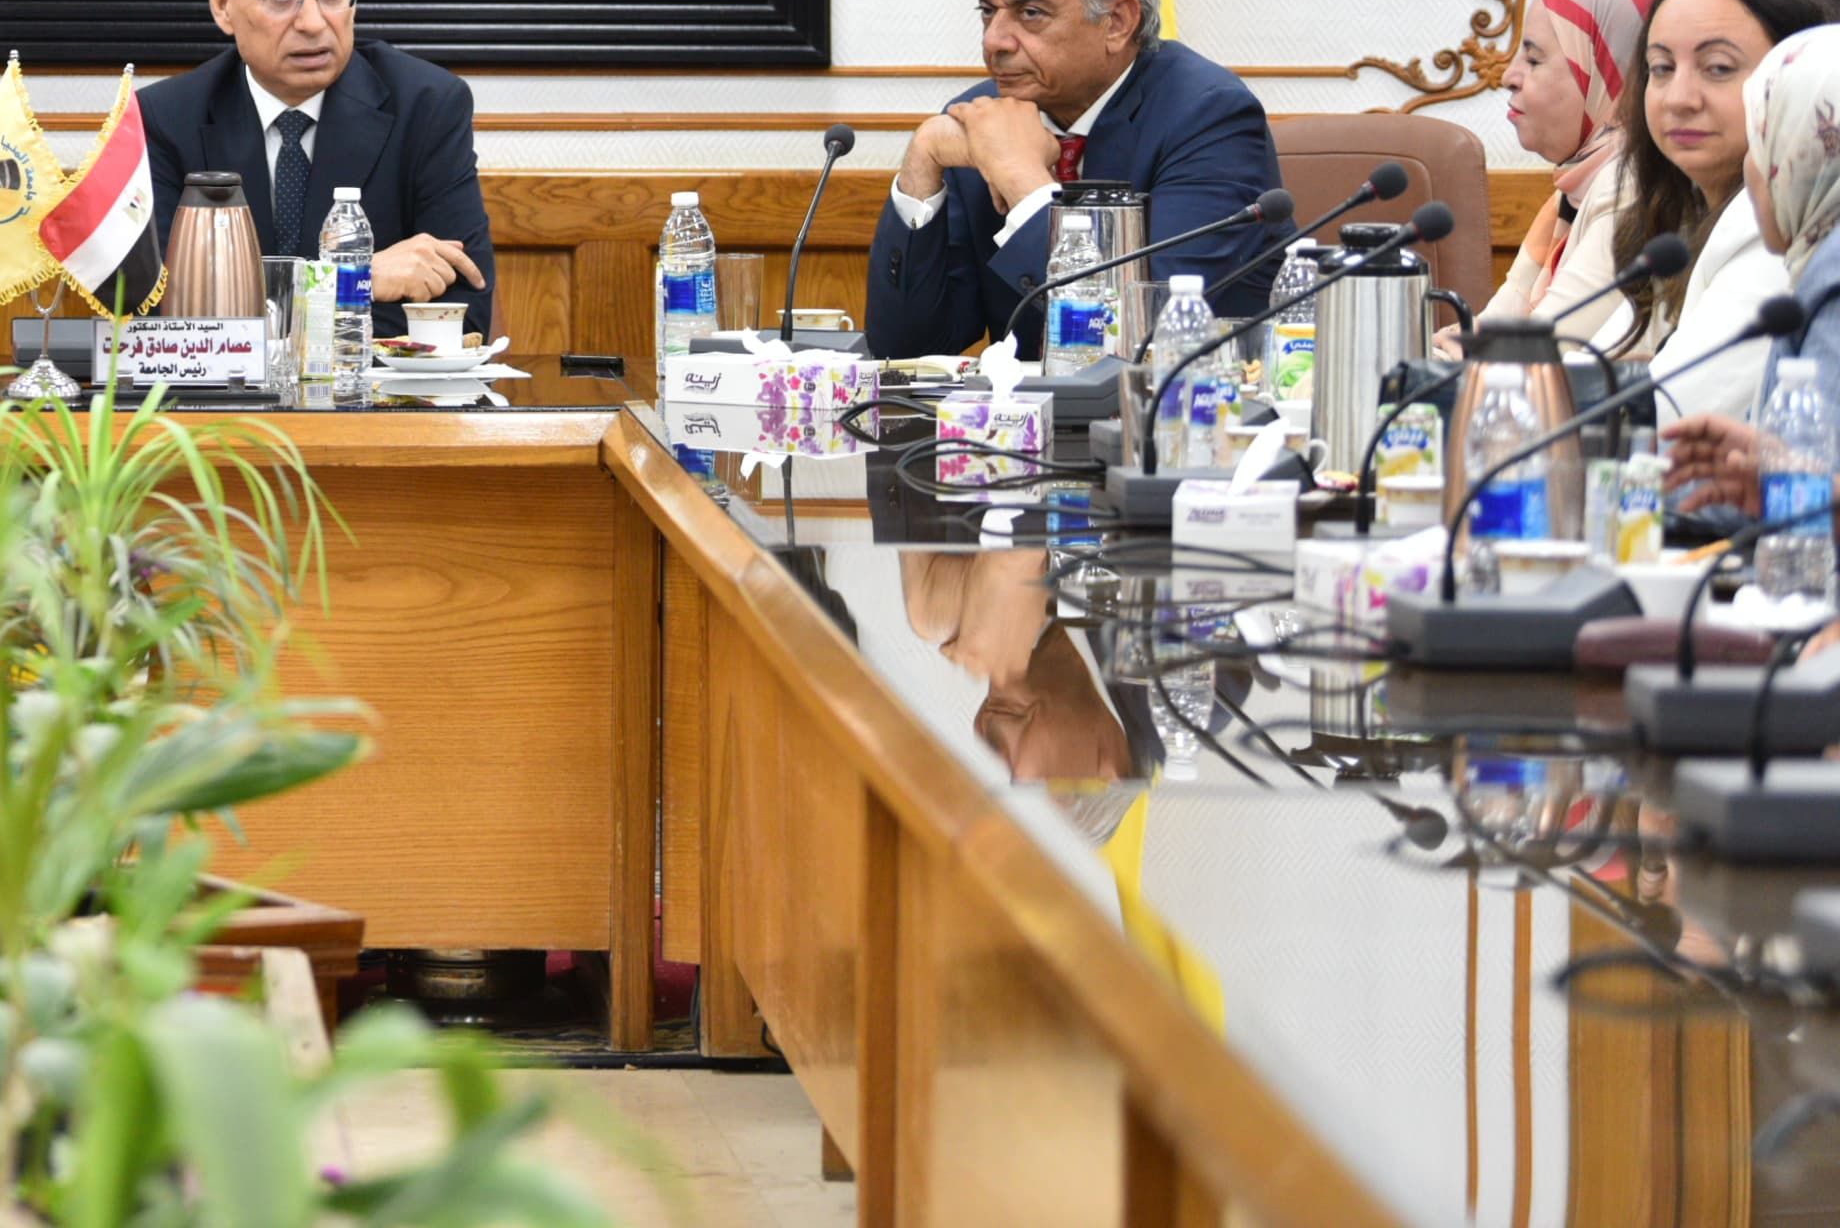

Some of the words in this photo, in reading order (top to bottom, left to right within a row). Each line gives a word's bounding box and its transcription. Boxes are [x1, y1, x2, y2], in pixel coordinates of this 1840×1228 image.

[126, 321, 161, 334] الدكتور
[198, 321, 224, 333] السيد
[102, 335, 144, 358] فرحت
[145, 336, 178, 358] صادق
[180, 337, 213, 359] الدين
[215, 337, 252, 355] عصام
[138, 361, 178, 378] الجامعة
[179, 361, 207, 378] رئيس
